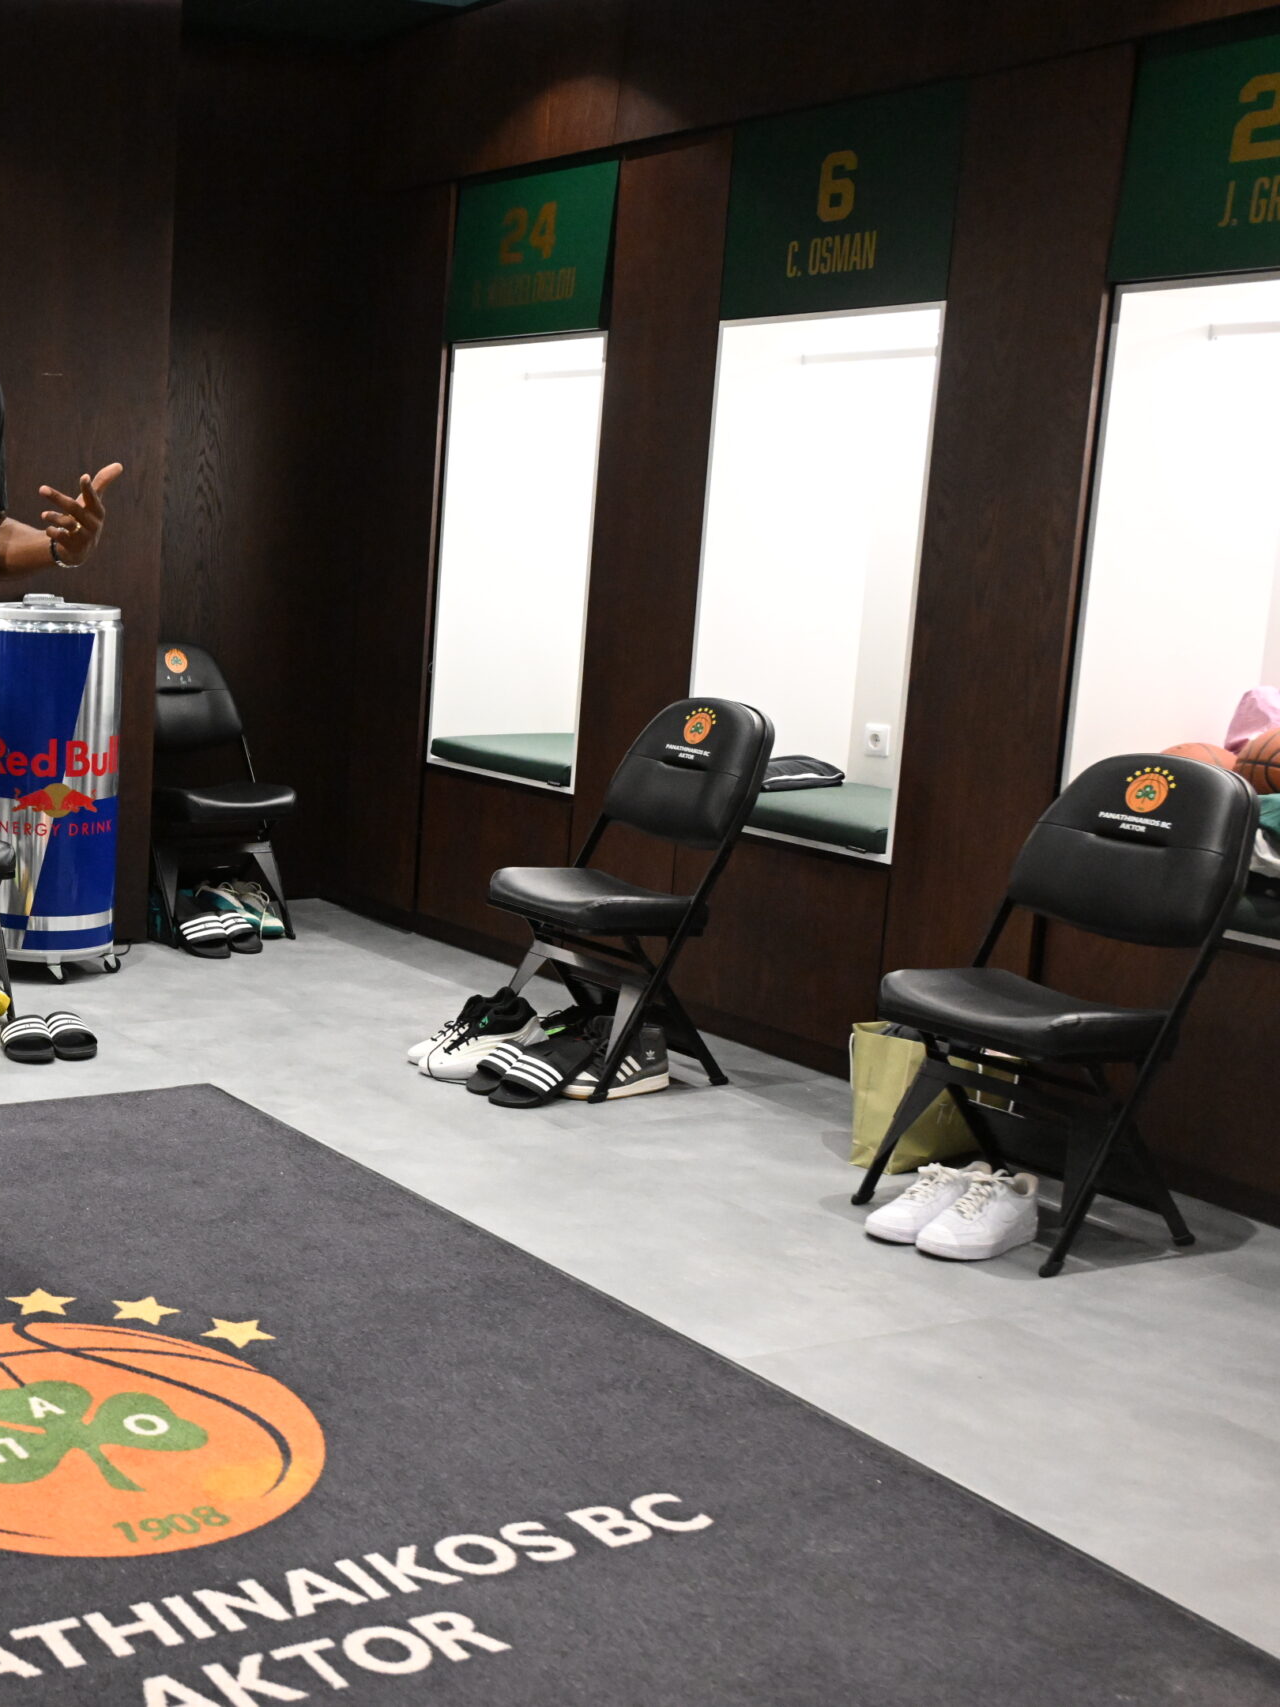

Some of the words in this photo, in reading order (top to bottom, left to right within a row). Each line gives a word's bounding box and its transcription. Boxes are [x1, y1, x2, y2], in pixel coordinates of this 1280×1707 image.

[817, 149, 858, 222] 6
[1217, 180, 1238, 228] J.
[499, 201, 558, 267] 24
[786, 240, 802, 278] C.
[808, 230, 878, 276] OSMAN
[68, 819, 113, 837] DRINK
[1119, 822, 1147, 832] AKTOR
[112, 1505, 231, 1543] 1908
[564, 1493, 714, 1548] BC
[142, 1610, 512, 1707] AKTOR
